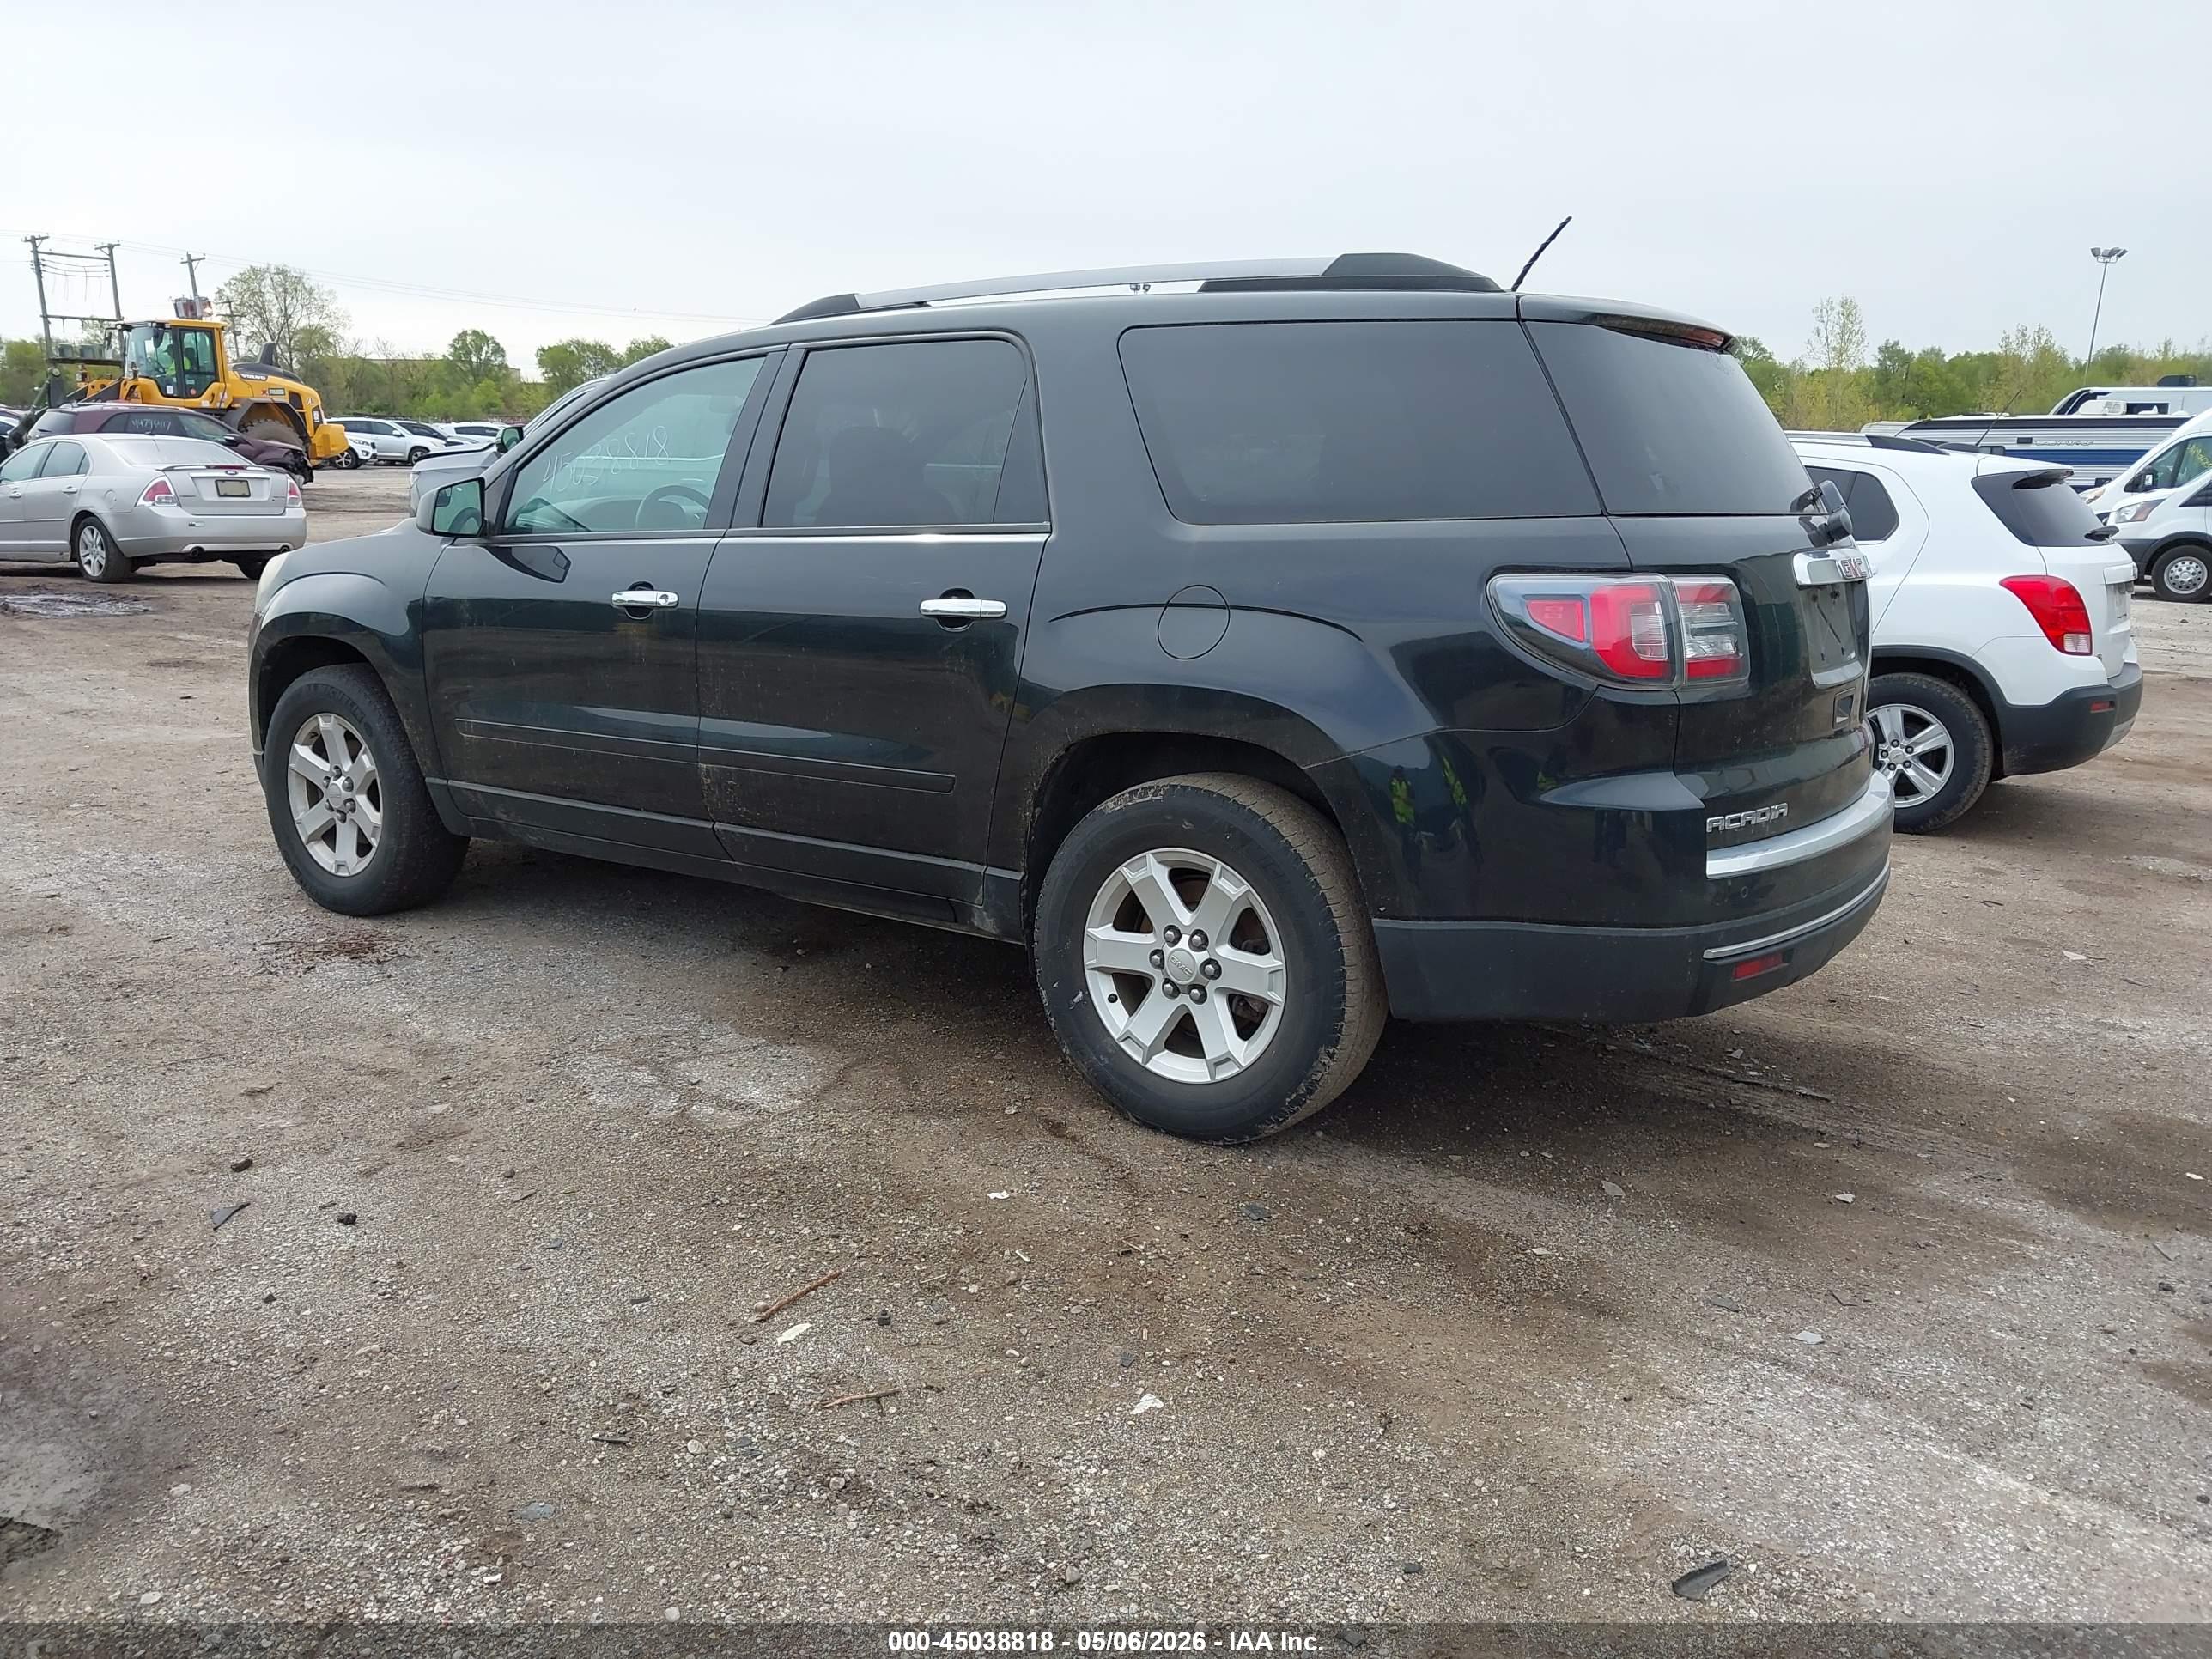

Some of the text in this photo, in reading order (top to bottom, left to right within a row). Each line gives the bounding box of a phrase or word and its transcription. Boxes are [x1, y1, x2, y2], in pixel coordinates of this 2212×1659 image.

[543, 426, 670, 494] 45038818
[1840, 557, 1869, 579] GMC
[1705, 802, 1789, 833] ACADIA
[1170, 955, 1194, 977] GMC
